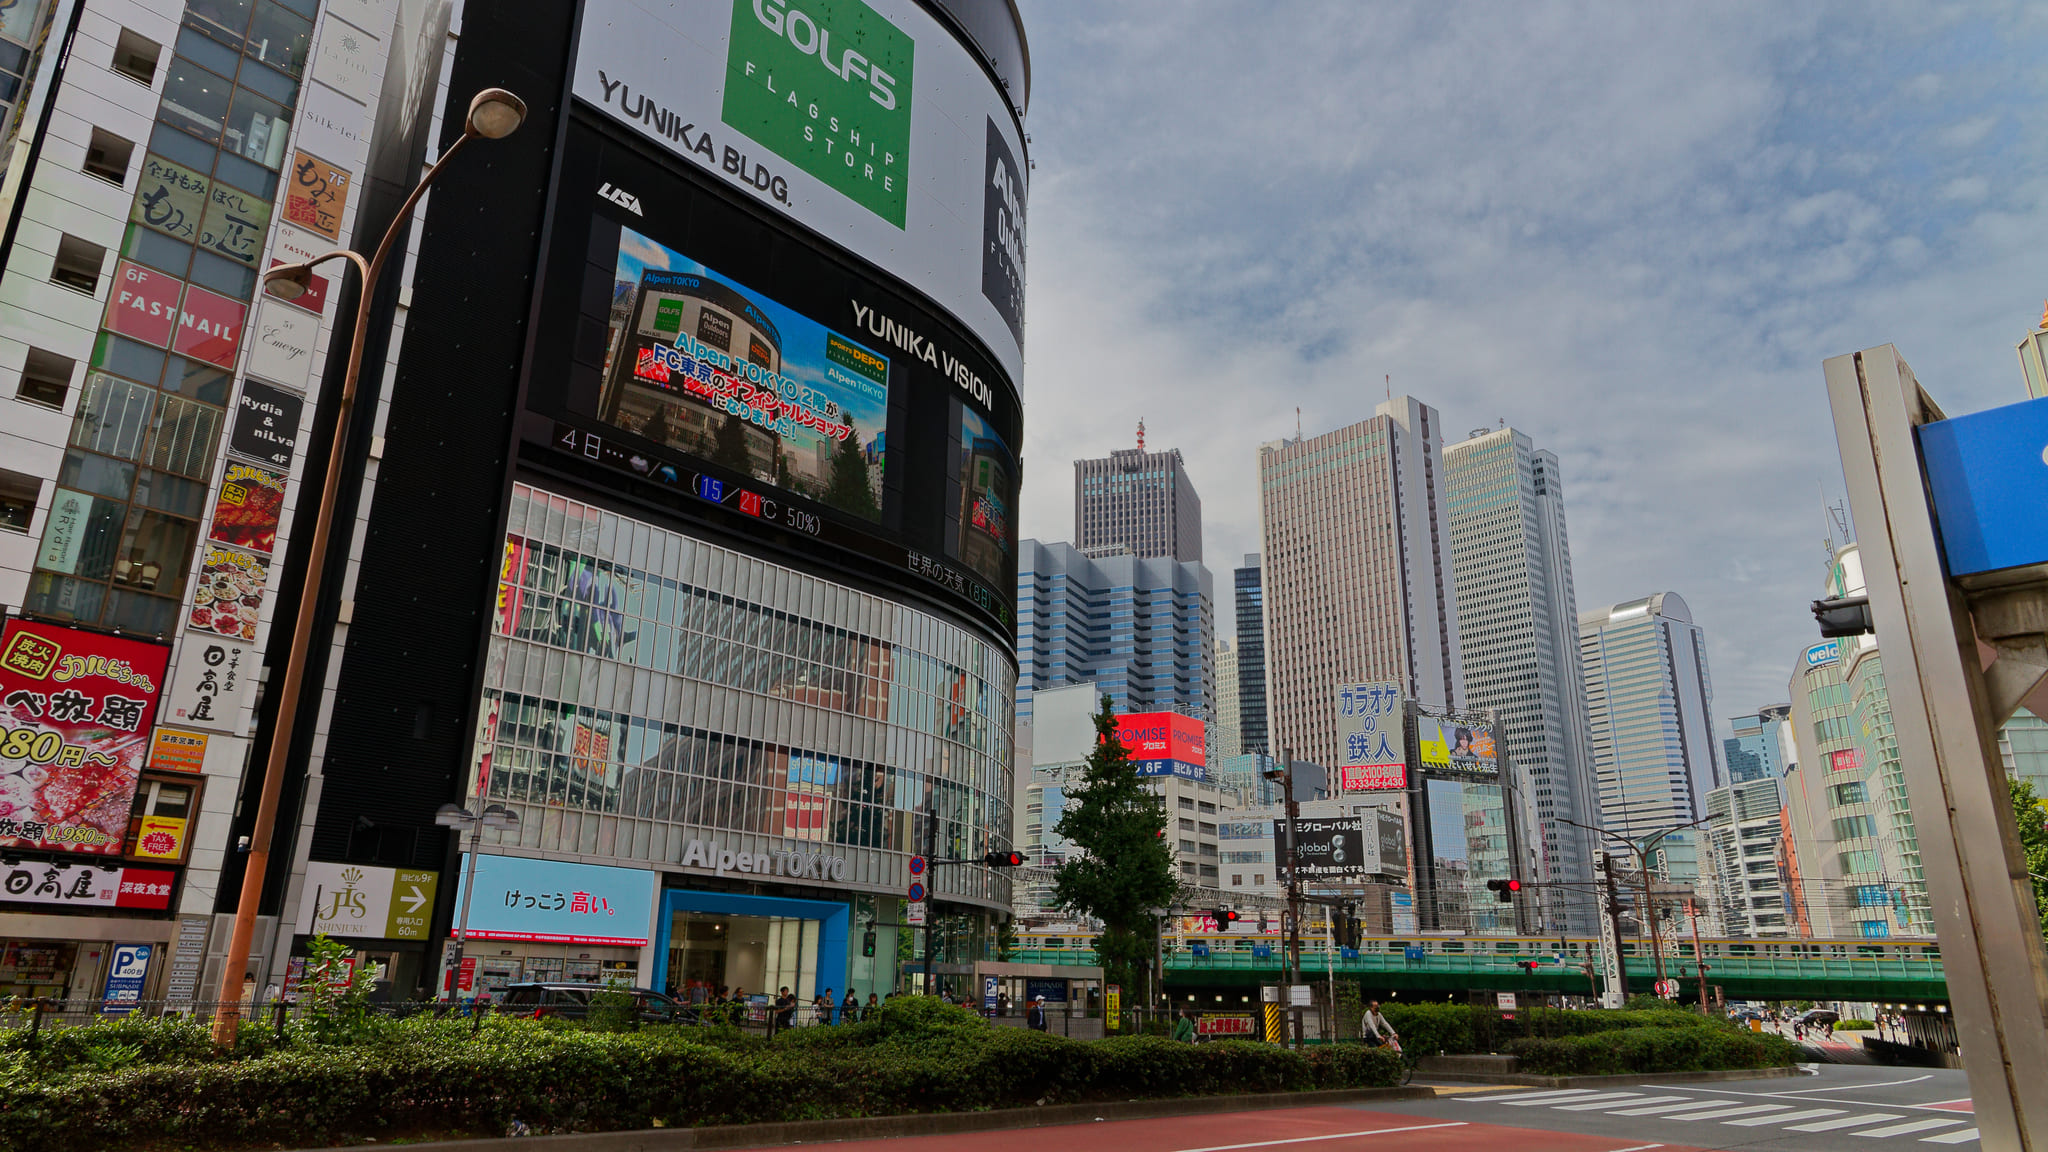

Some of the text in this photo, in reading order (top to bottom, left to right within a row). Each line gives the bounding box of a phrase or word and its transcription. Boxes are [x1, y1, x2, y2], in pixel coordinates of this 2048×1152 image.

[752, 0, 896, 111] GOLF5
[745, 61, 894, 166] FLAGSHIP
[598, 69, 793, 207] YUNIKA BLDG.
[804, 126, 893, 192] STORE
[328, 171, 346, 187] 7F
[597, 182, 643, 216] LISA
[125, 268, 149, 284] 6F
[644, 273, 700, 288] Alpen TOKYO
[118, 290, 233, 342] FASTNAIL
[851, 299, 992, 412] YUNIKA VISION
[853, 349, 885, 371] DEPO
[674, 331, 732, 370] Alpen
[735, 357, 798, 400] TOKYO
[801, 388, 839, 418] 2階が
[828, 367, 883, 400] Alpen TOKYO
[241, 395, 283, 417] Rydia
[263, 416, 274, 428] &
[253, 429, 295, 448] niLva
[271, 453, 288, 464] 4F
[907, 549, 965, 595] 世界の天気
[16, 638, 52, 662] 炭火
[9, 651, 46, 674] 焼肉
[53, 654, 155, 692] カルビちゃん
[188, 645, 225, 721] 日高屋
[1340, 683, 1398, 717] カラオケ
[1112, 727, 1166, 742] ROMISE
[1364, 715, 1376, 733] の
[1142, 742, 1166, 750] プロミス
[1173, 729, 1202, 747] PROMISE
[1347, 732, 1397, 762] 鉄人
[1146, 762, 1162, 773] 6F
[1173, 761, 1204, 778] 当ビル 6F
[147, 842, 169, 851] FREE
[151, 834, 166, 843] TAX
[681, 839, 847, 881] Alpen TOKYO
[1297, 842, 1330, 859] global
[5, 868, 96, 899] 日高屋
[120, 881, 171, 896] 深夜食堂
[317, 923, 367, 933] SHINJUKU
[398, 926, 417, 936] 60m
